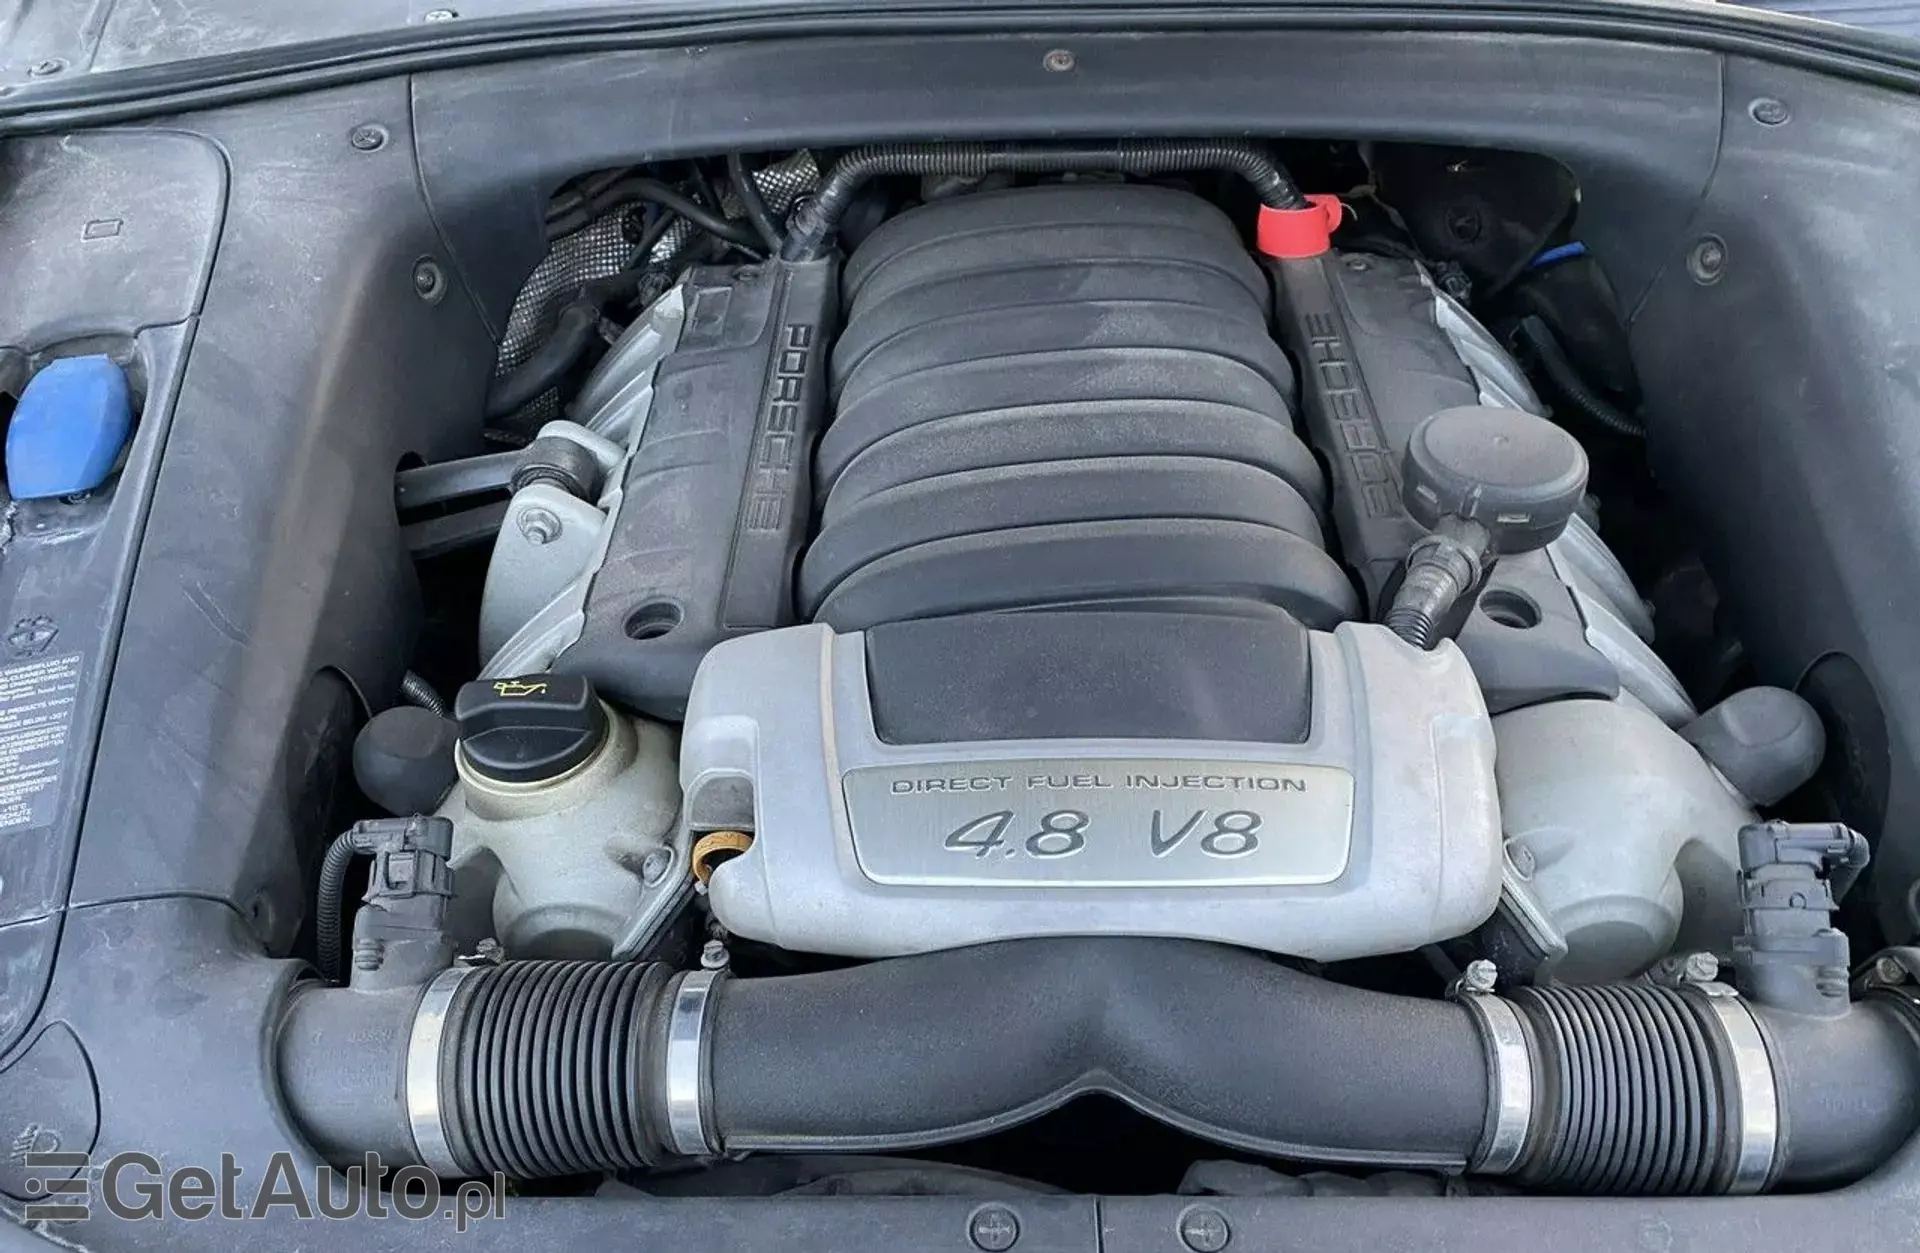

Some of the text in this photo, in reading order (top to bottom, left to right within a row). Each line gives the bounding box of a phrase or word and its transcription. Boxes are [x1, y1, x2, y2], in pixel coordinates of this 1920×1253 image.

[744, 323, 812, 531] PORSCHE
[1304, 313, 1402, 519] PORSCHE
[891, 774, 1307, 794] DIRECT FUEL INJECTION
[944, 809, 1265, 858] 4.8 V8
